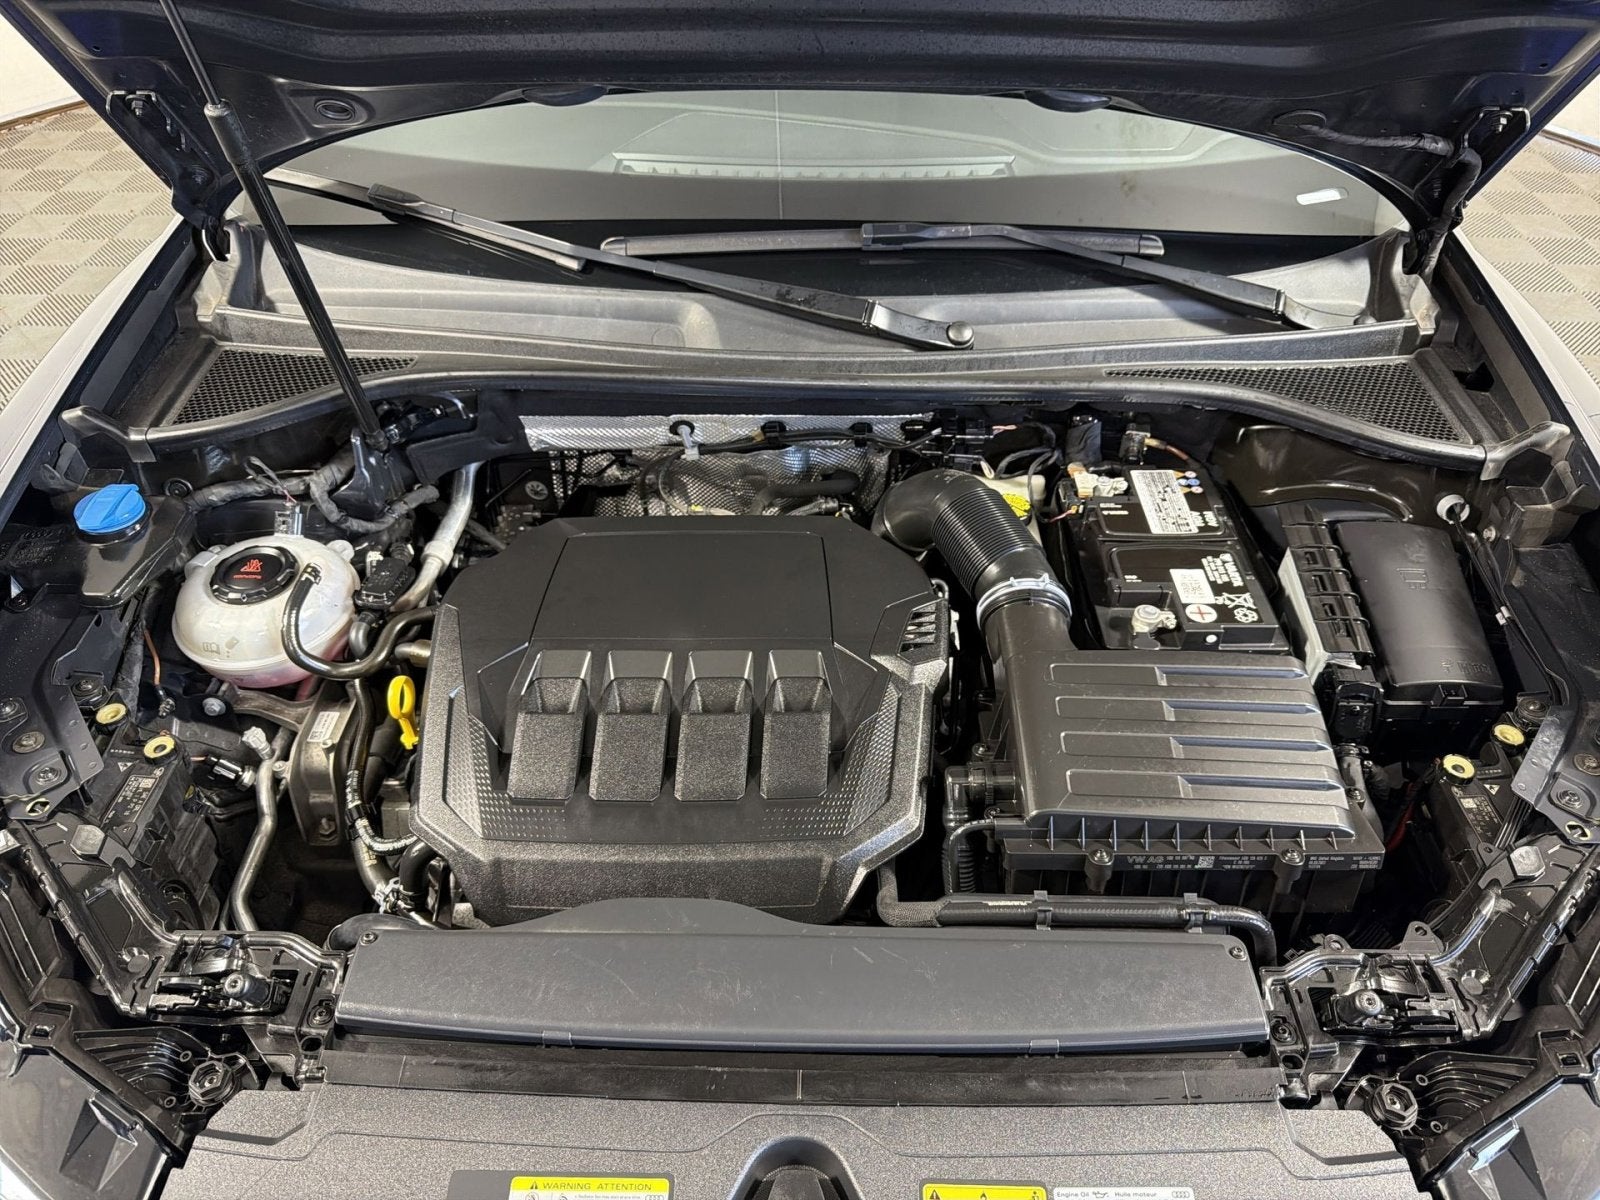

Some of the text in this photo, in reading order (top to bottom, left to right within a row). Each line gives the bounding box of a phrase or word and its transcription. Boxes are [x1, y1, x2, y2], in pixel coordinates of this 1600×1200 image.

[543, 1182, 652, 1191] WARNING ATTENTION
[1056, 1191, 1079, 1199] Engine
